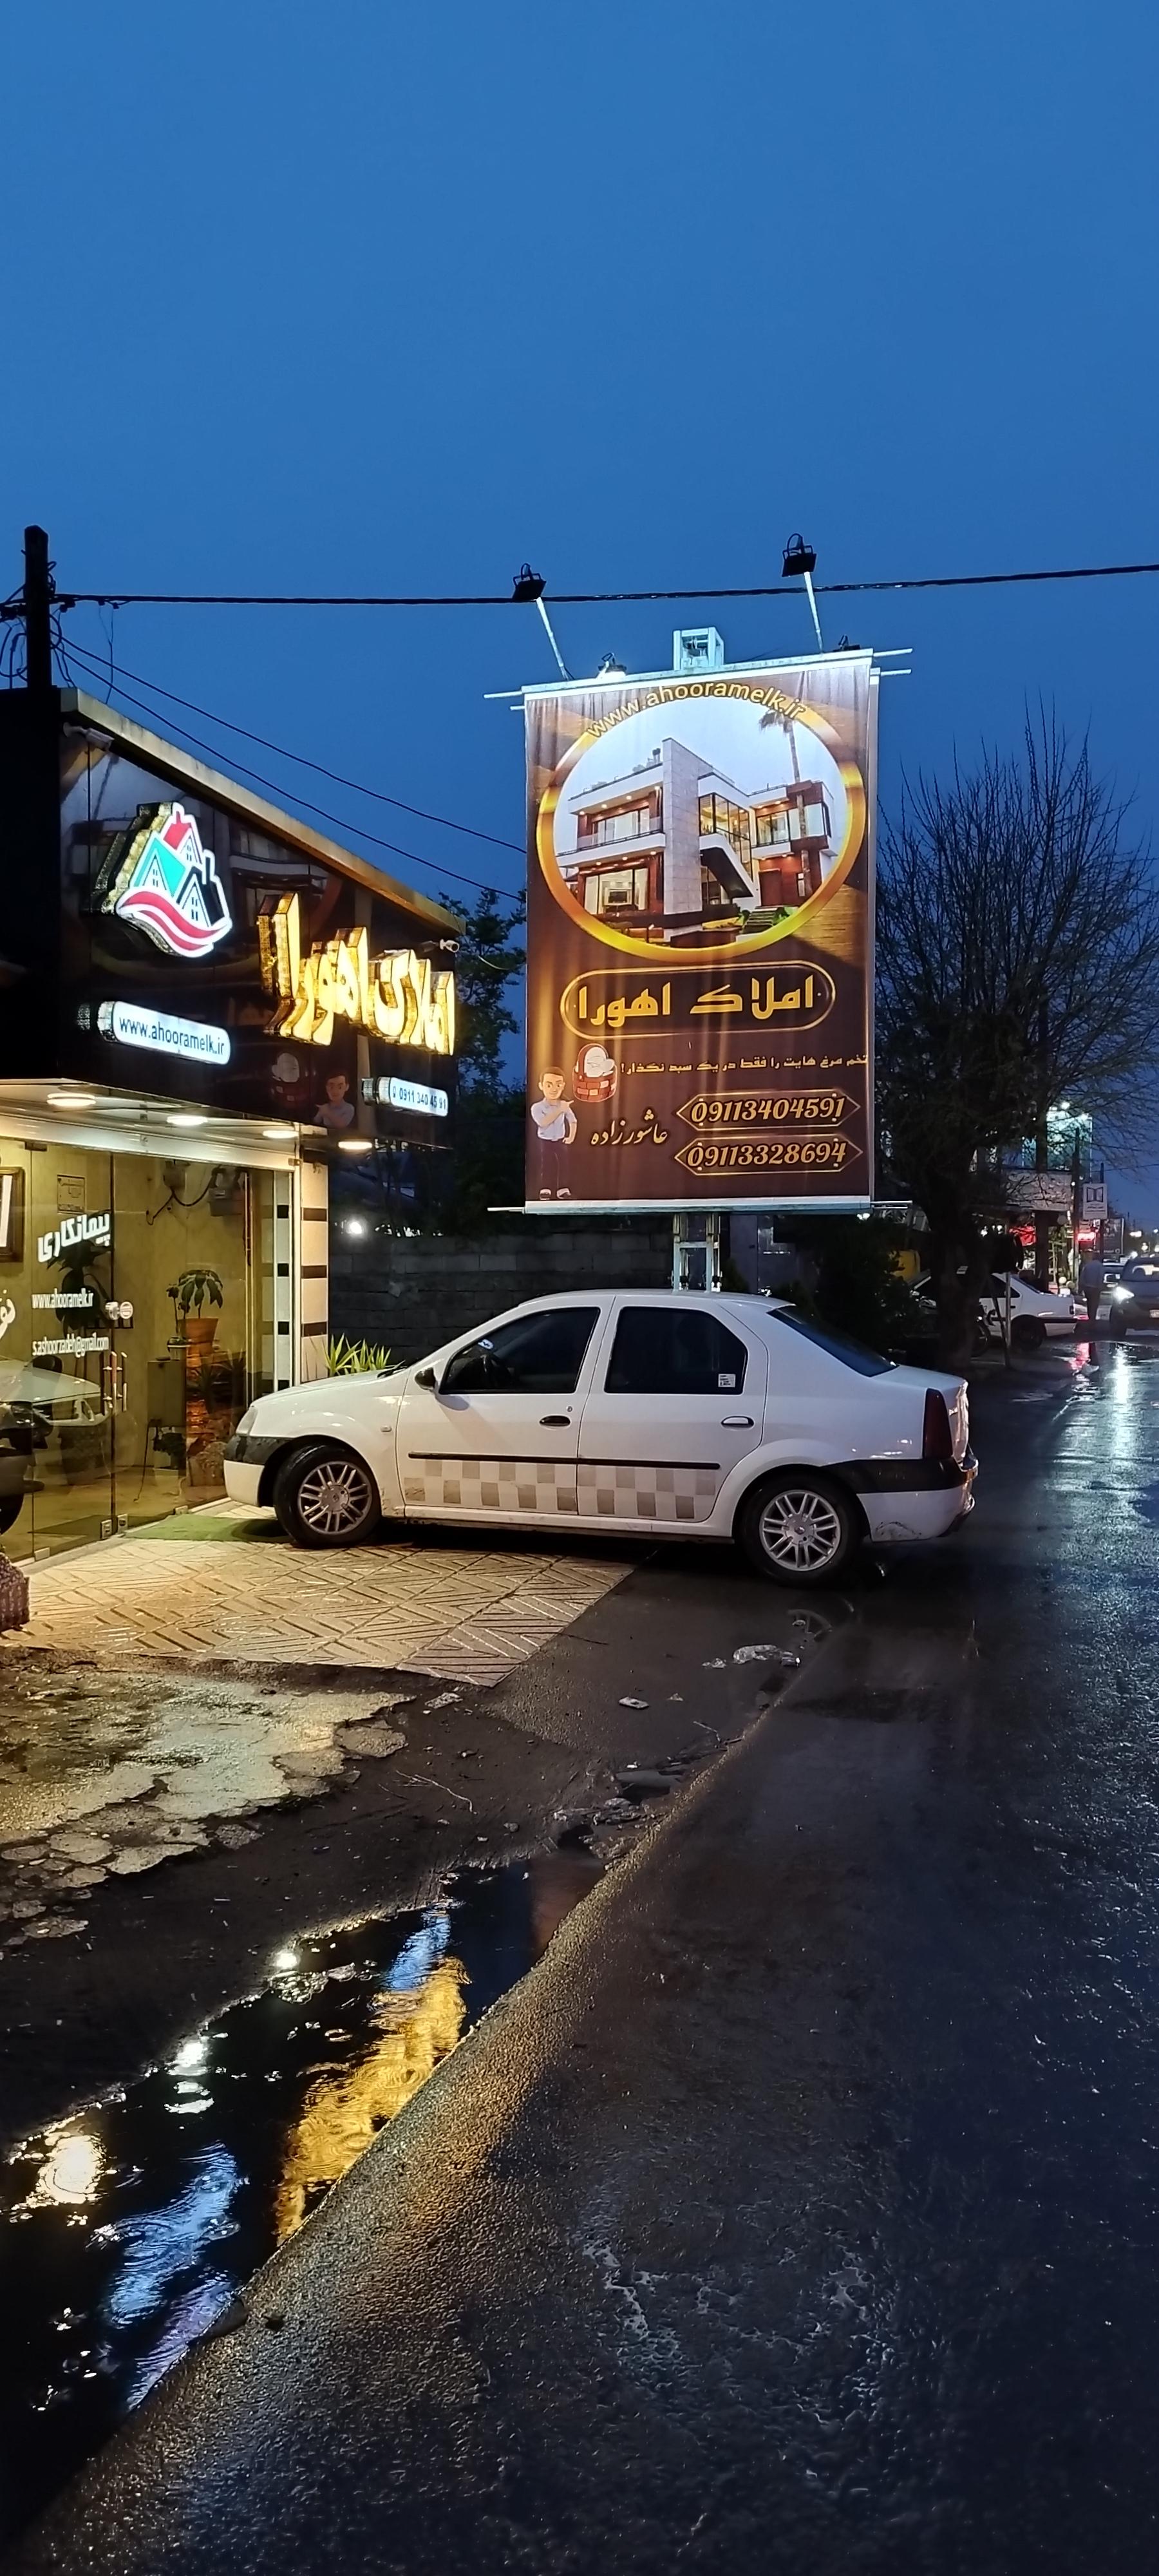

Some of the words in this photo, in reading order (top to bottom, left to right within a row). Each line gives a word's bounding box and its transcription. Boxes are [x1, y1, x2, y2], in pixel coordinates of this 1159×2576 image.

[587, 682, 805, 738] www.ahooramelk.ir
[579, 981, 671, 1027] اهورا
[119, 1017, 225, 1055] www.ahooramelk.ir
[668, 1063, 692, 1074] سبد
[722, 1063, 736, 1072] در
[740, 1056, 767, 1068] فقط
[771, 1057, 780, 1069] را
[783, 1056, 816, 1069] هایت
[820, 1056, 843, 1068] مرغ
[399, 1087, 415, 1103] 0911
[690, 1097, 845, 1122] 09113404591
[686, 1142, 847, 1167] 09113328694
[32, 1287, 94, 1309] www.ahooramelk.ir
